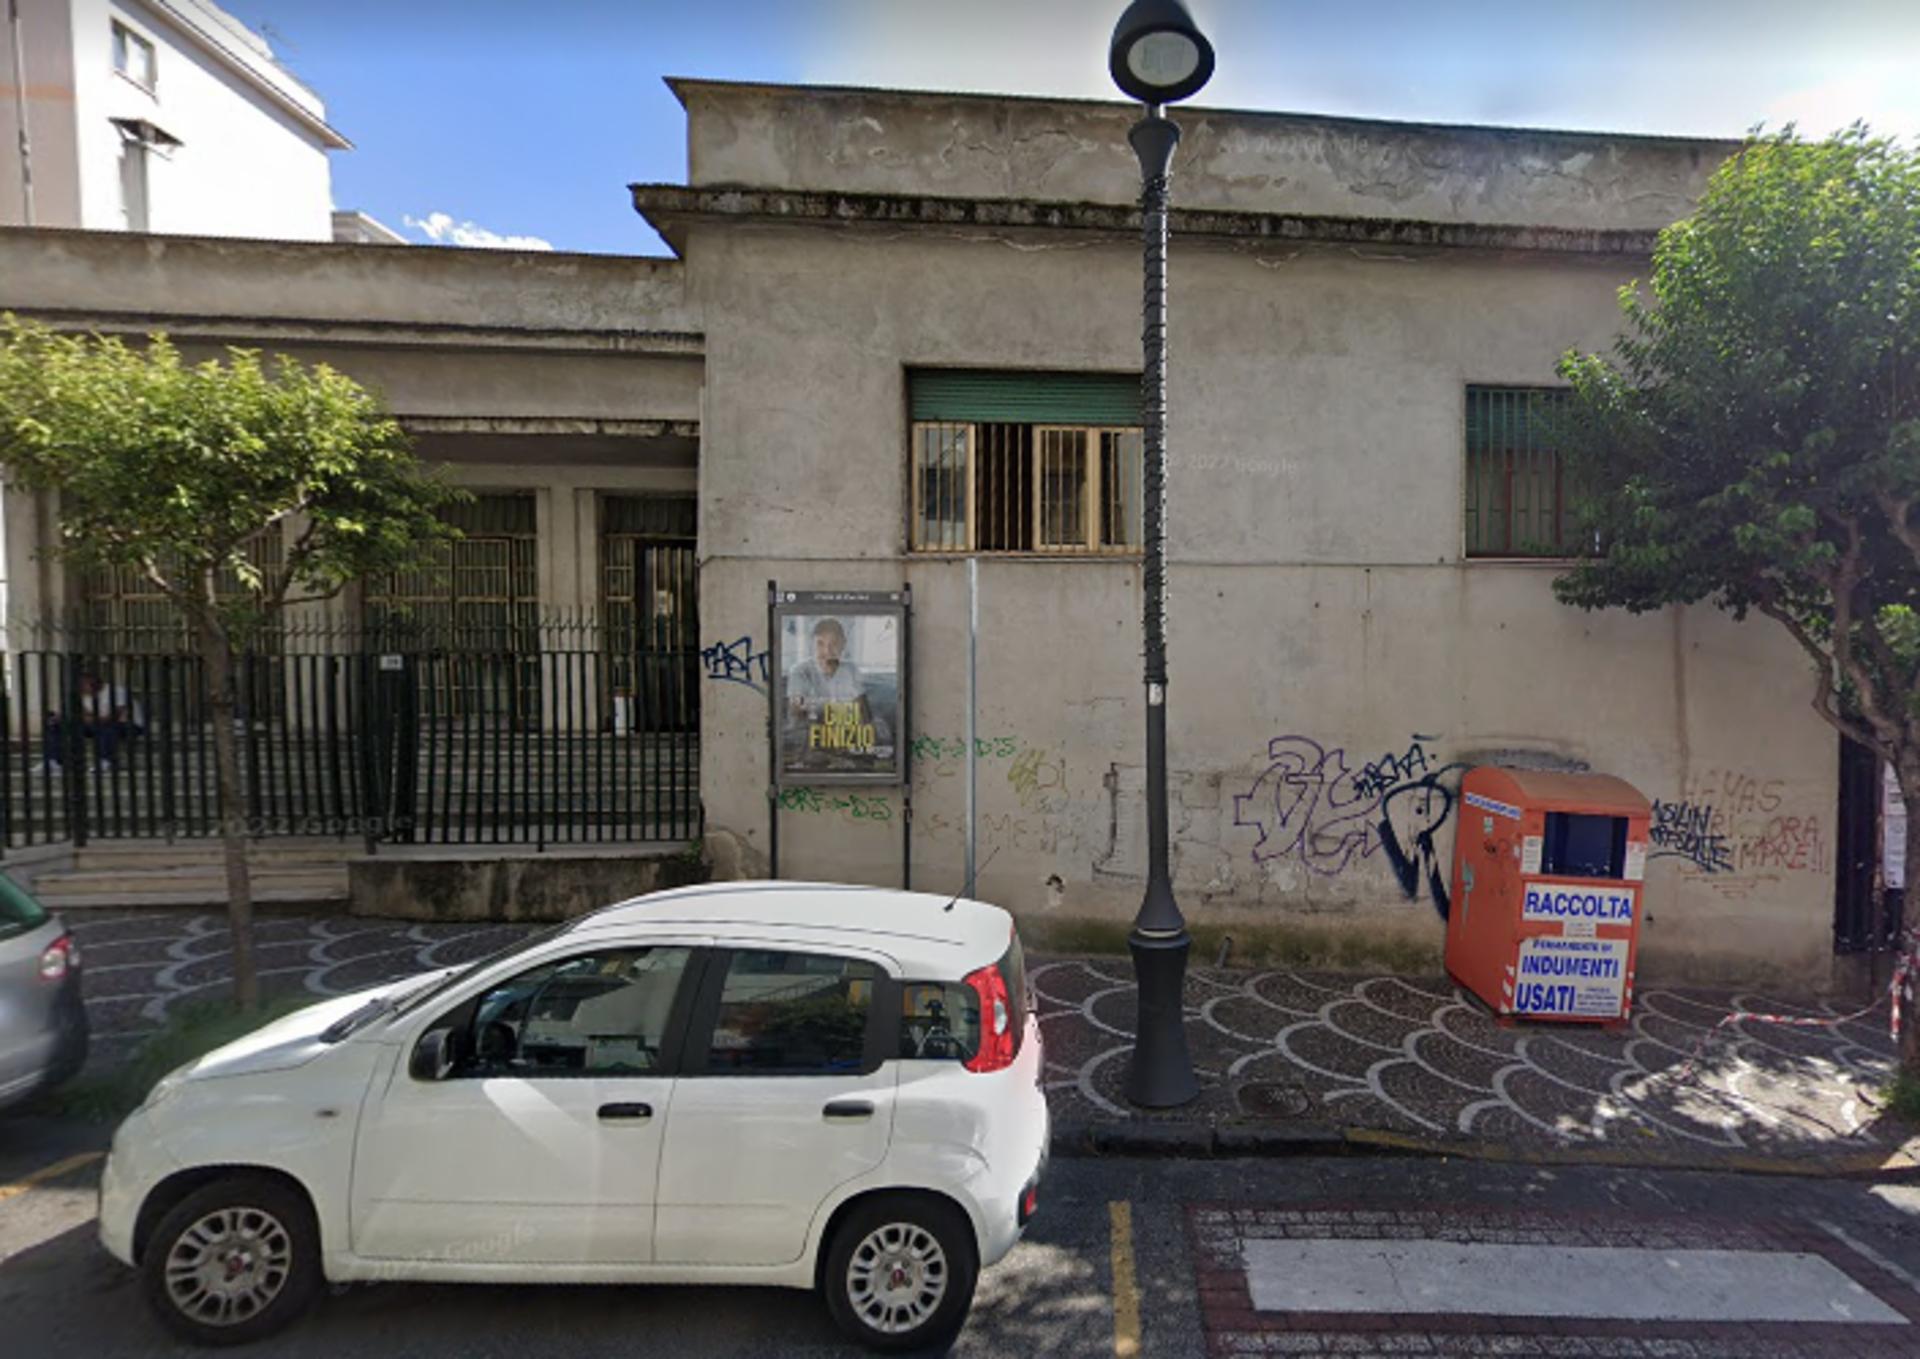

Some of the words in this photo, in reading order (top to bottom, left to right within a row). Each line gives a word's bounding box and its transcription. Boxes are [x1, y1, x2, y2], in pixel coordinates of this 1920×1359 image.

[809, 724, 875, 749] FINIZIO
[1525, 892, 1632, 919] RACCOLTA
[1522, 955, 1619, 978] INDUMENTI
[1516, 983, 1576, 1012] USATI
